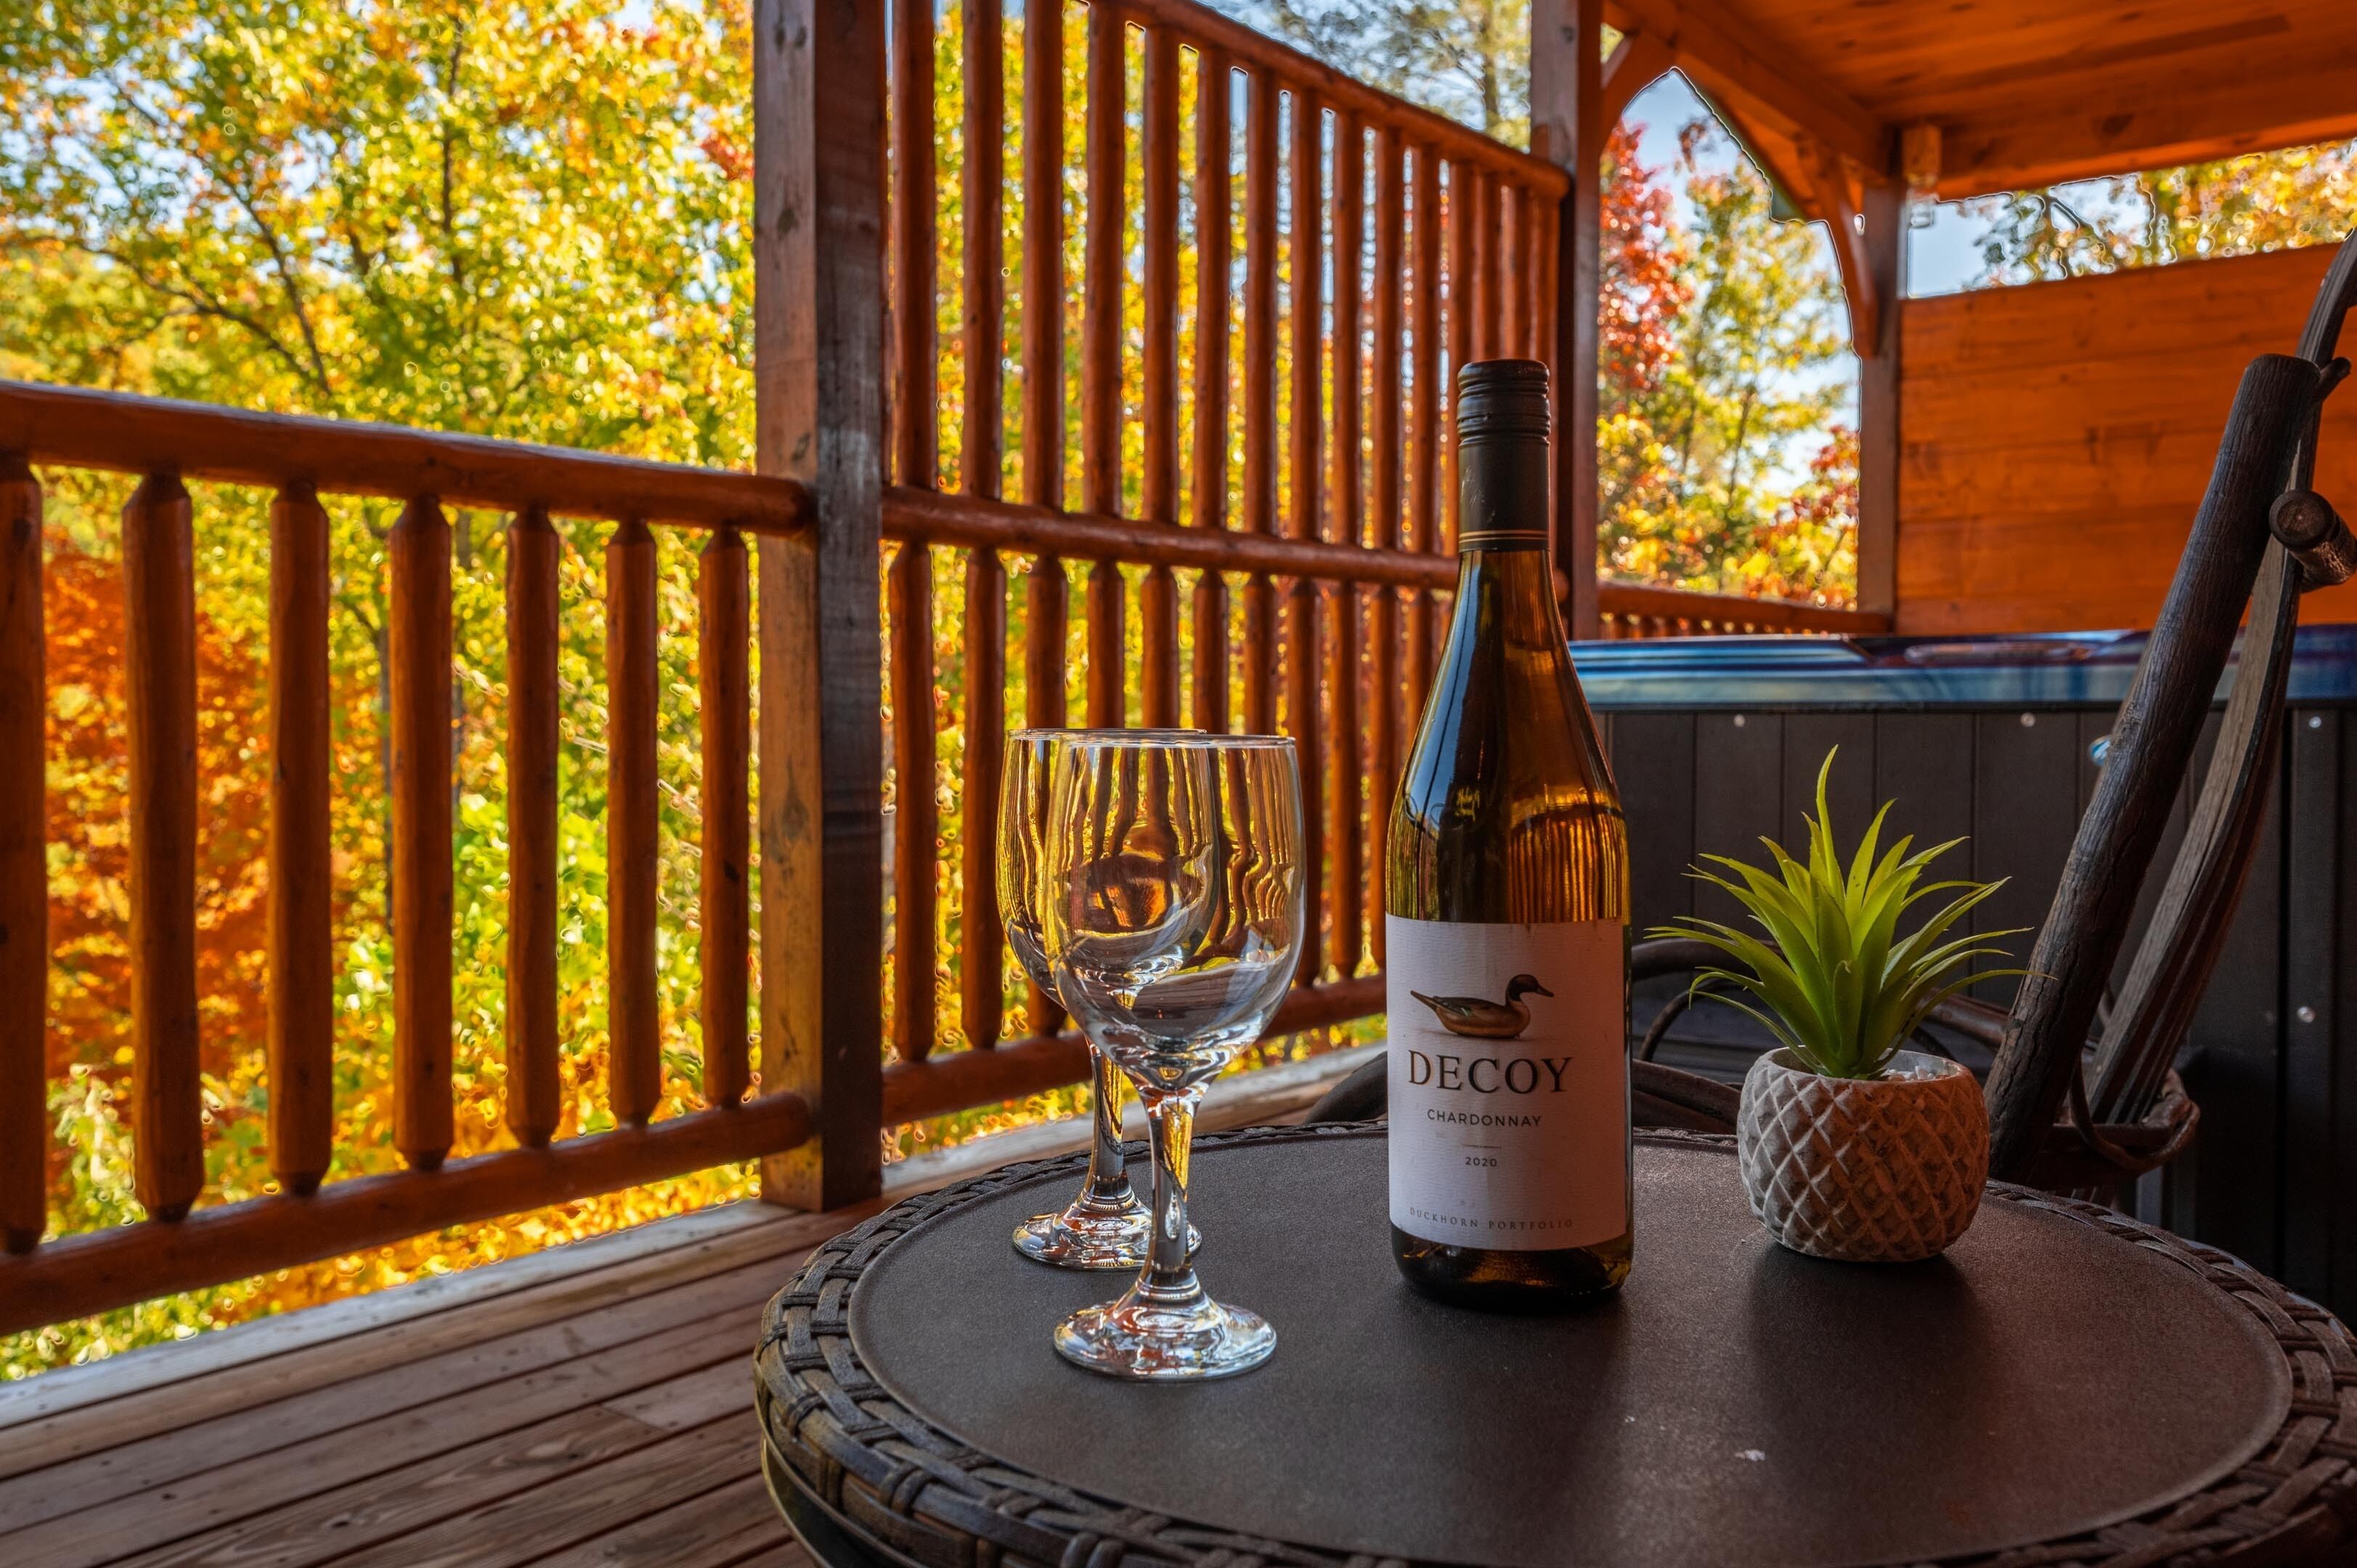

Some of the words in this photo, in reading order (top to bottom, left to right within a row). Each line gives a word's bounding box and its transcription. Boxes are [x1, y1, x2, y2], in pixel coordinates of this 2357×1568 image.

[1409, 1050, 1573, 1093] DECOY
[1427, 1108, 1542, 1127] CHARDONNAY
[1465, 1156, 1498, 1168] 2020
[1409, 1206, 1478, 1228] DUCKHORN
[1489, 1218, 1573, 1230] PORTFOLIO
